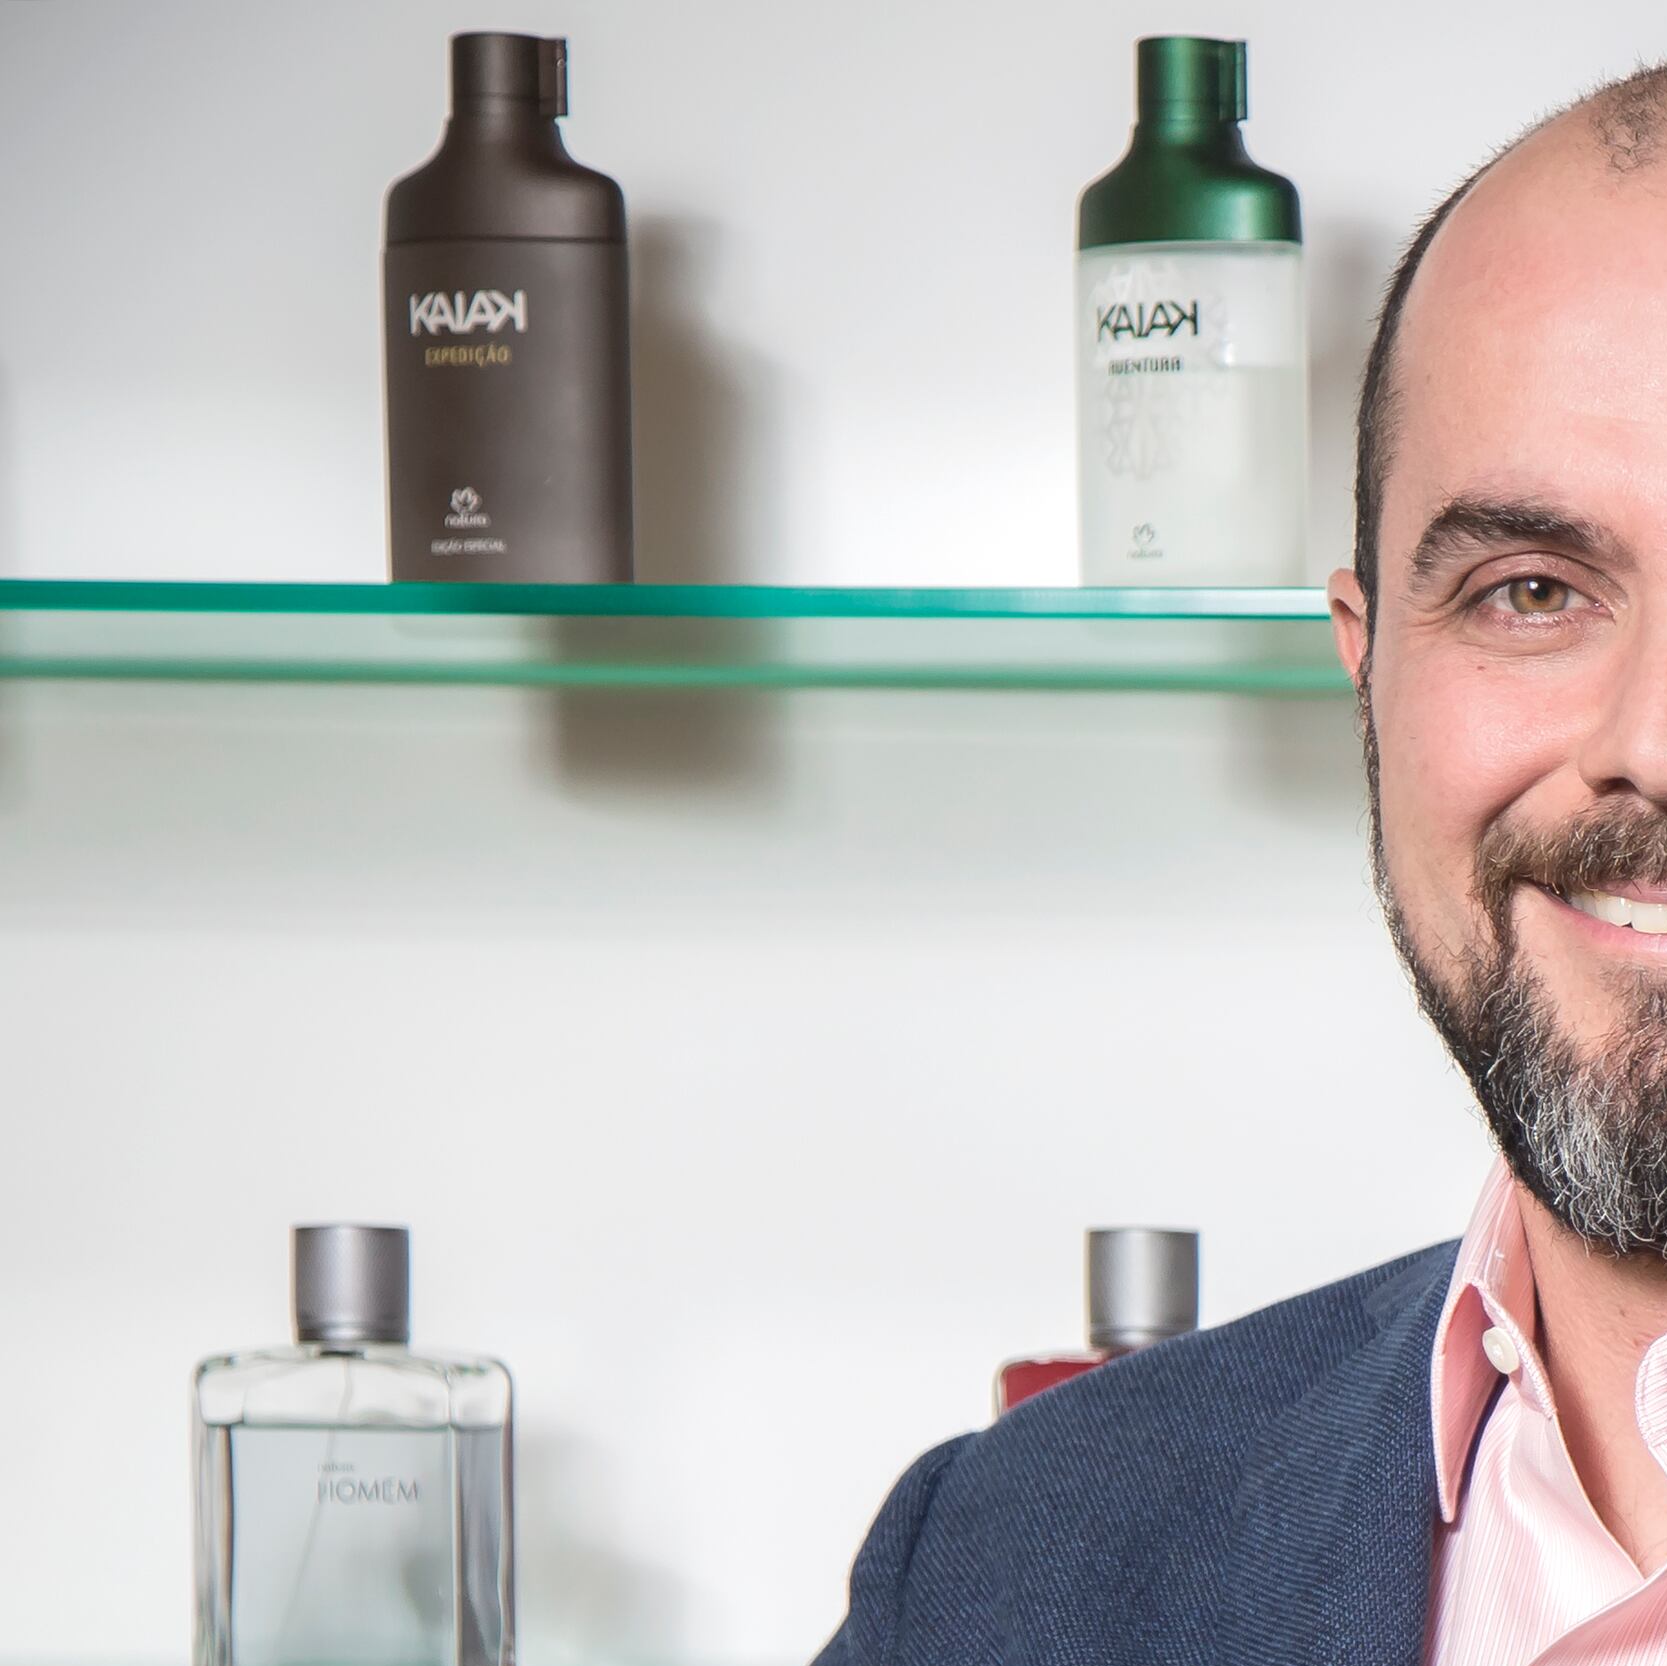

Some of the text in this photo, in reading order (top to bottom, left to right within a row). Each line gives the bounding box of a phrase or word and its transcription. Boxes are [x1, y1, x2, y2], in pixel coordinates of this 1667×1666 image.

[408, 289, 528, 337] KAIAK
[1096, 299, 1199, 342] KAIAK
[425, 342, 512, 368] EXPEDIÇÃO
[1108, 356, 1184, 376] AVENTURA
[317, 1477, 420, 1505] HOMEM
